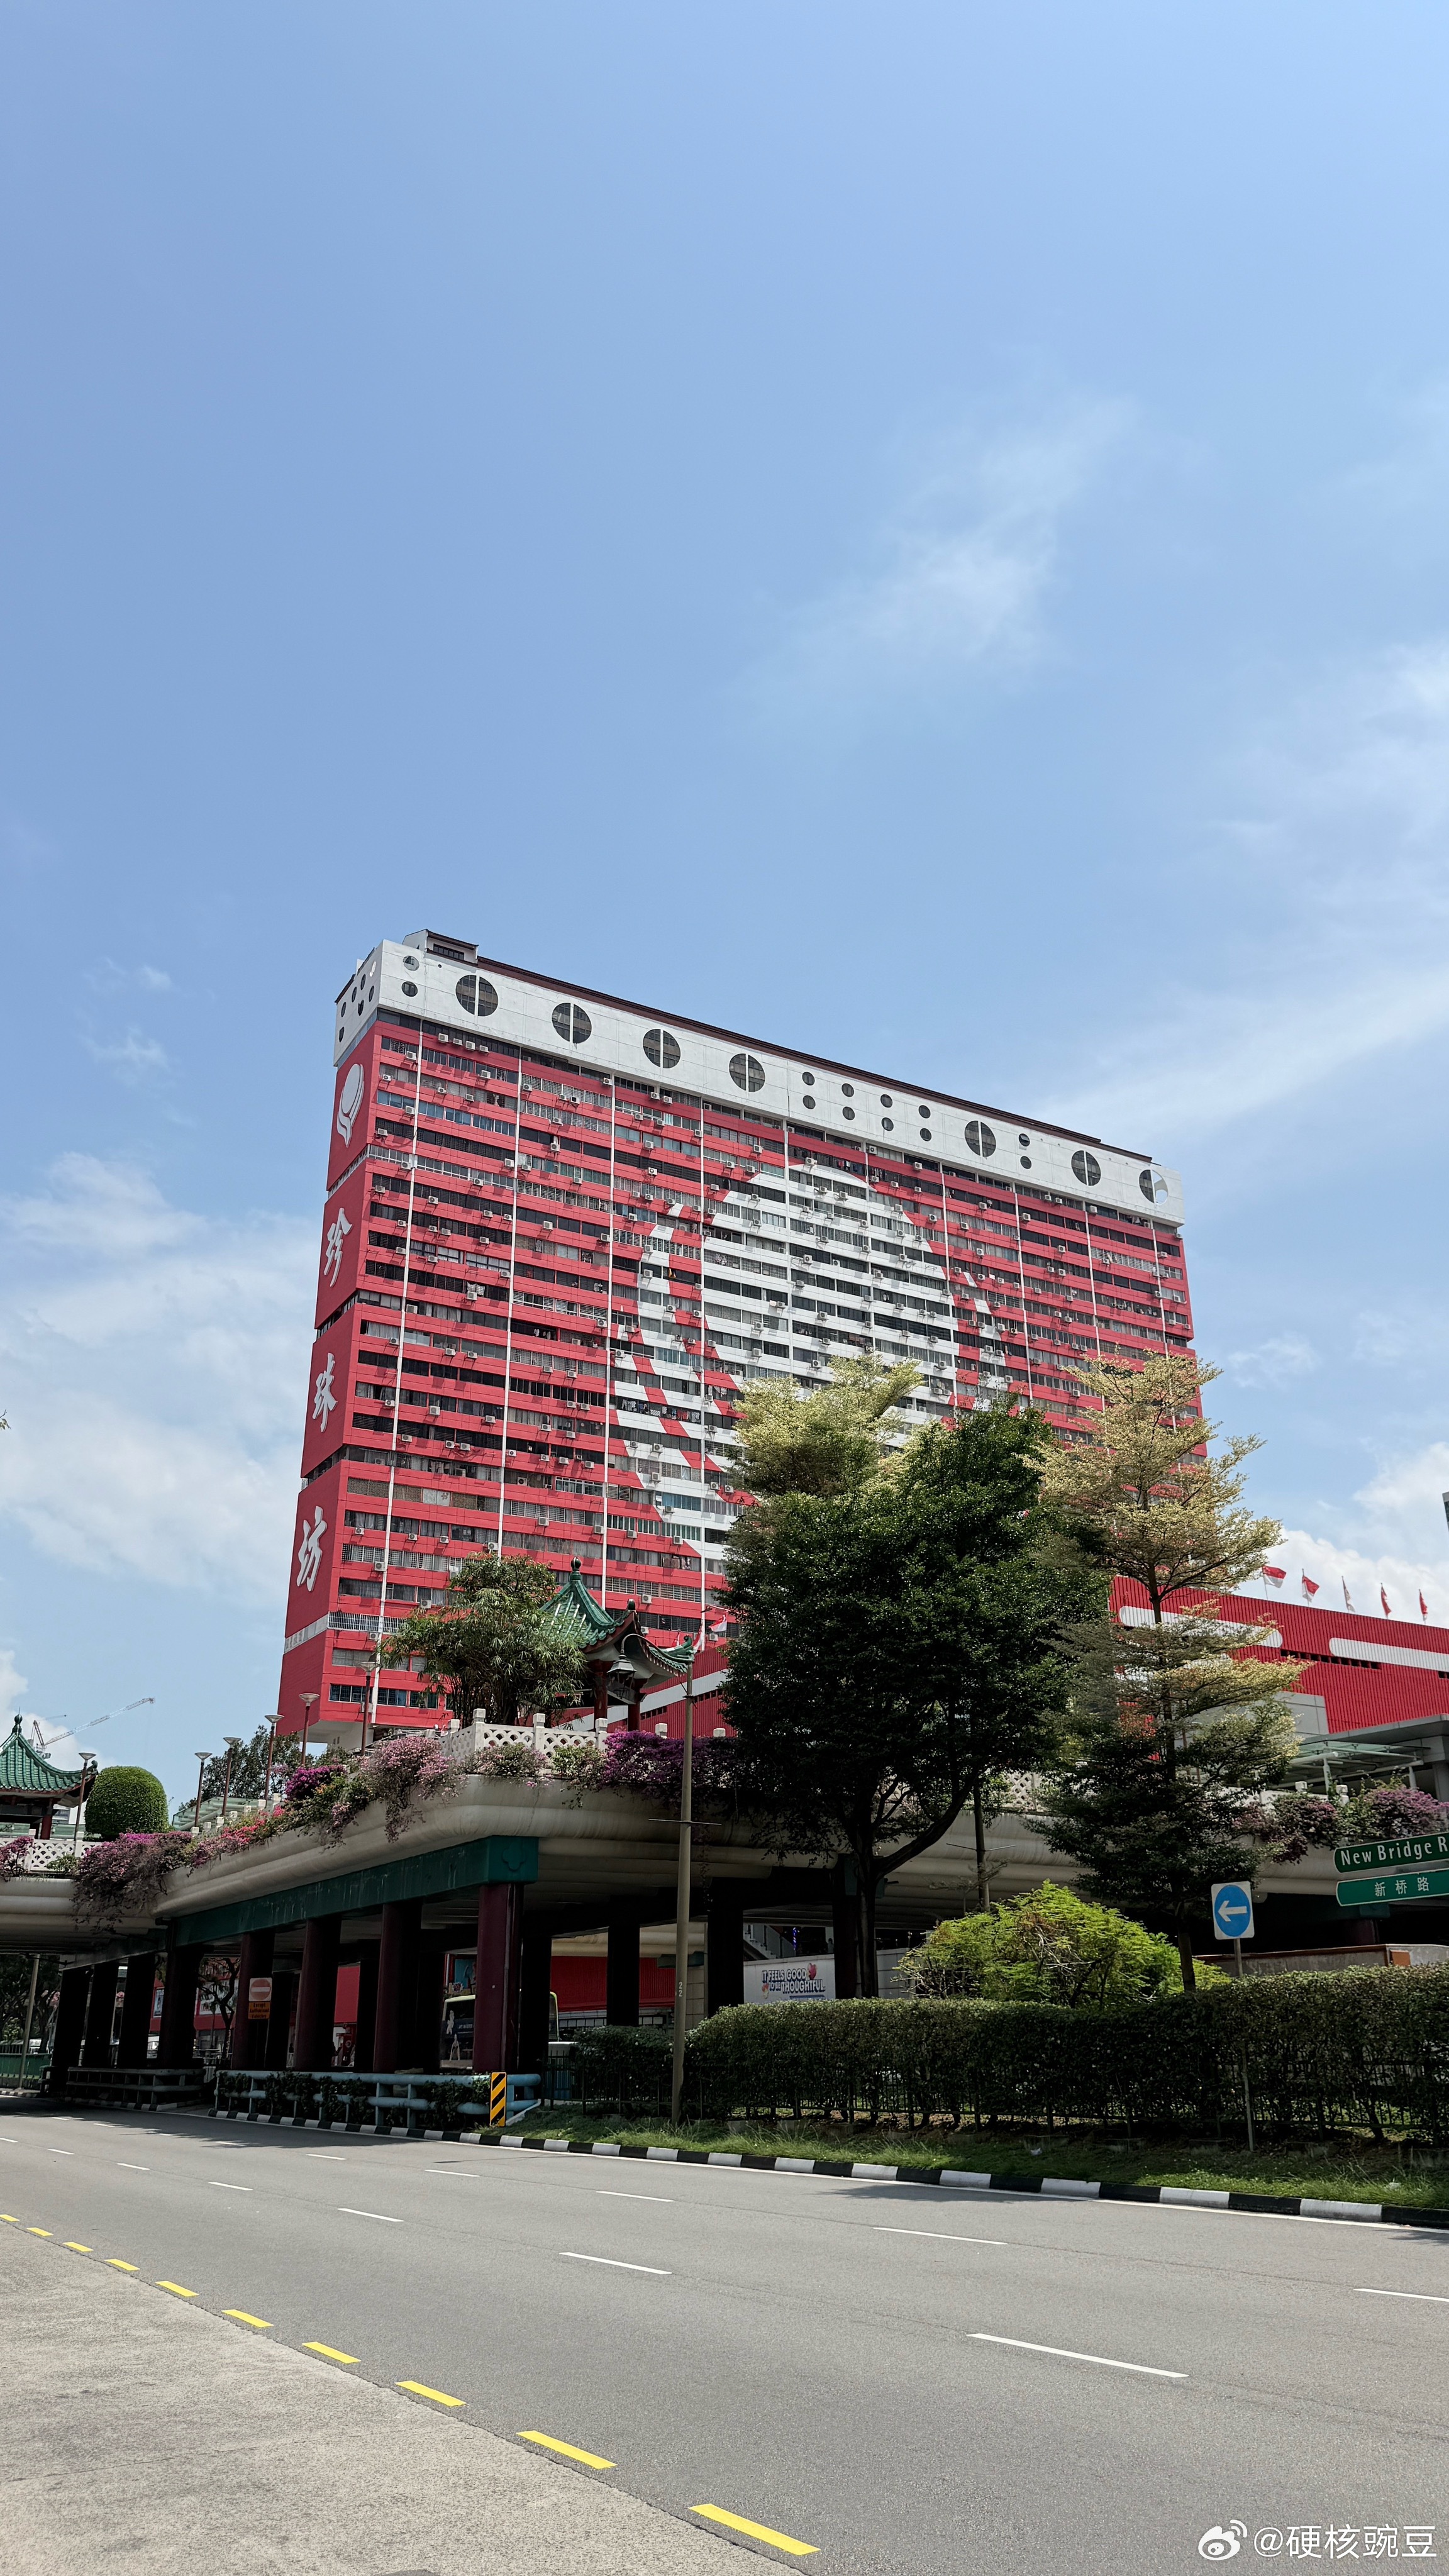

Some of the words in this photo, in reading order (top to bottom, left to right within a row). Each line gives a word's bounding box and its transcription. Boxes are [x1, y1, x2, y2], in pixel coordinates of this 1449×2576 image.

[296, 1208, 353, 1592] 珍珠坊
[1340, 1850, 1372, 1866] New
[1377, 1841, 1433, 1861] Bridge
[1374, 1876, 1430, 1897] 新桥路
[762, 1970, 768, 1983] IT
[769, 1970, 786, 1982] FEELS
[786, 1968, 807, 1981] GOOD
[769, 1982, 775, 1991] TO
